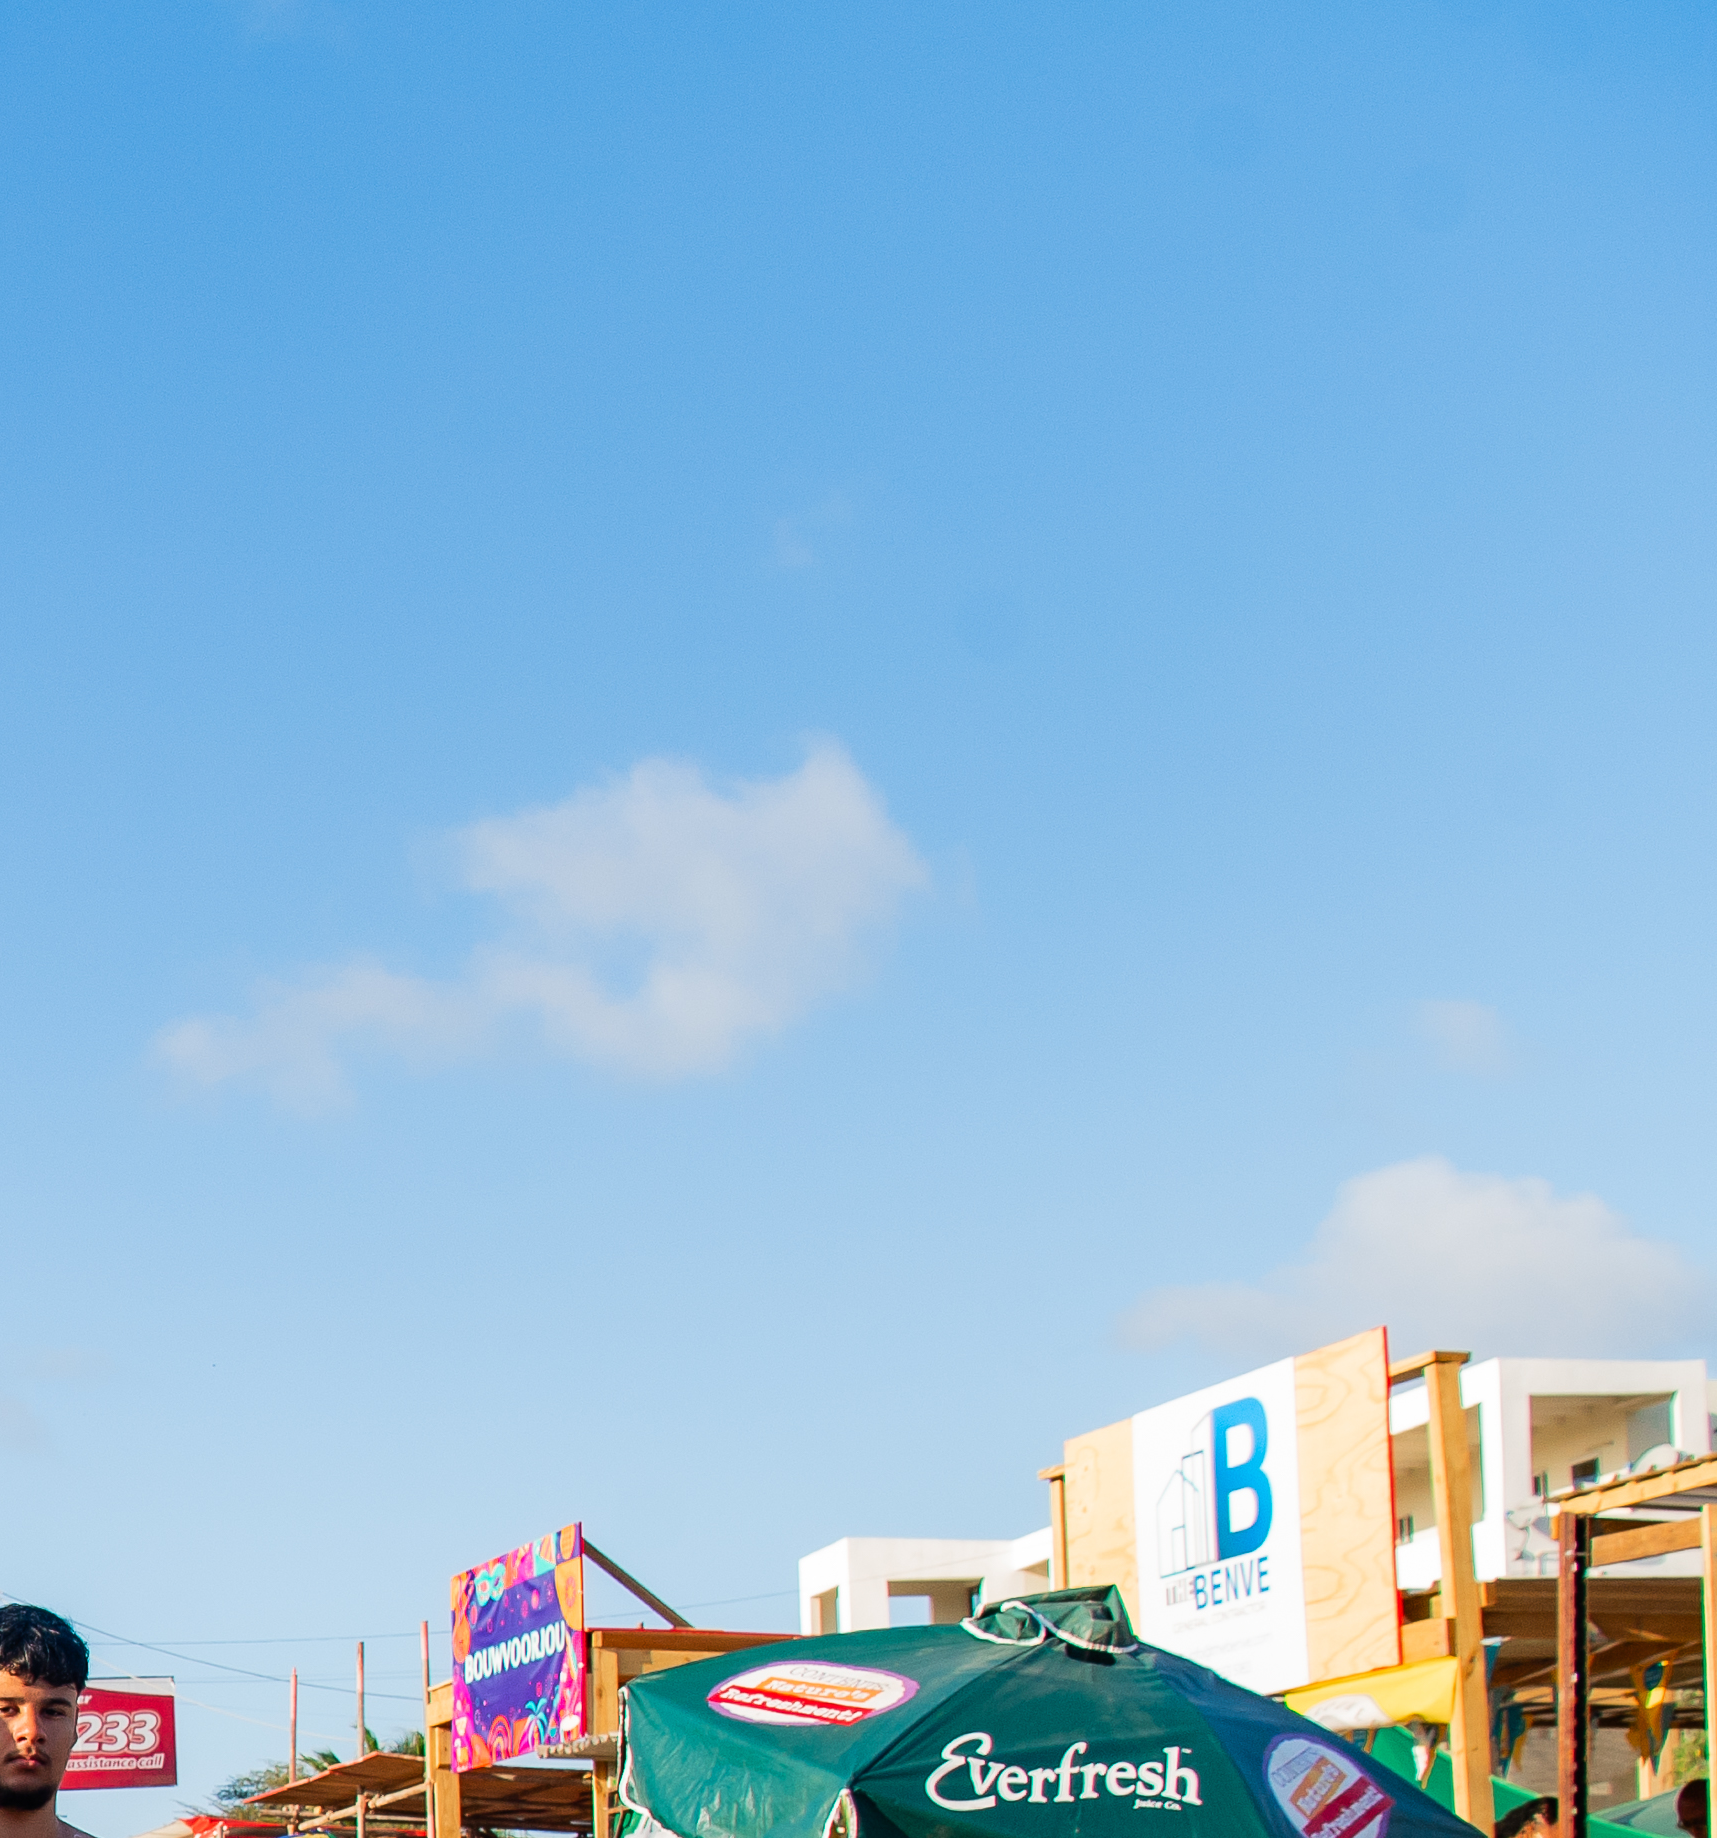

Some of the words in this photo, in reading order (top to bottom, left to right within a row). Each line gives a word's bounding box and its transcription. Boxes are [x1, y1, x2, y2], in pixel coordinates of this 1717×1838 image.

[1193, 1556, 1270, 1610] BENVE
[66, 1756, 137, 1771] assistance
[138, 1753, 165, 1769] call
[925, 1732, 1203, 1811] Everfresh
